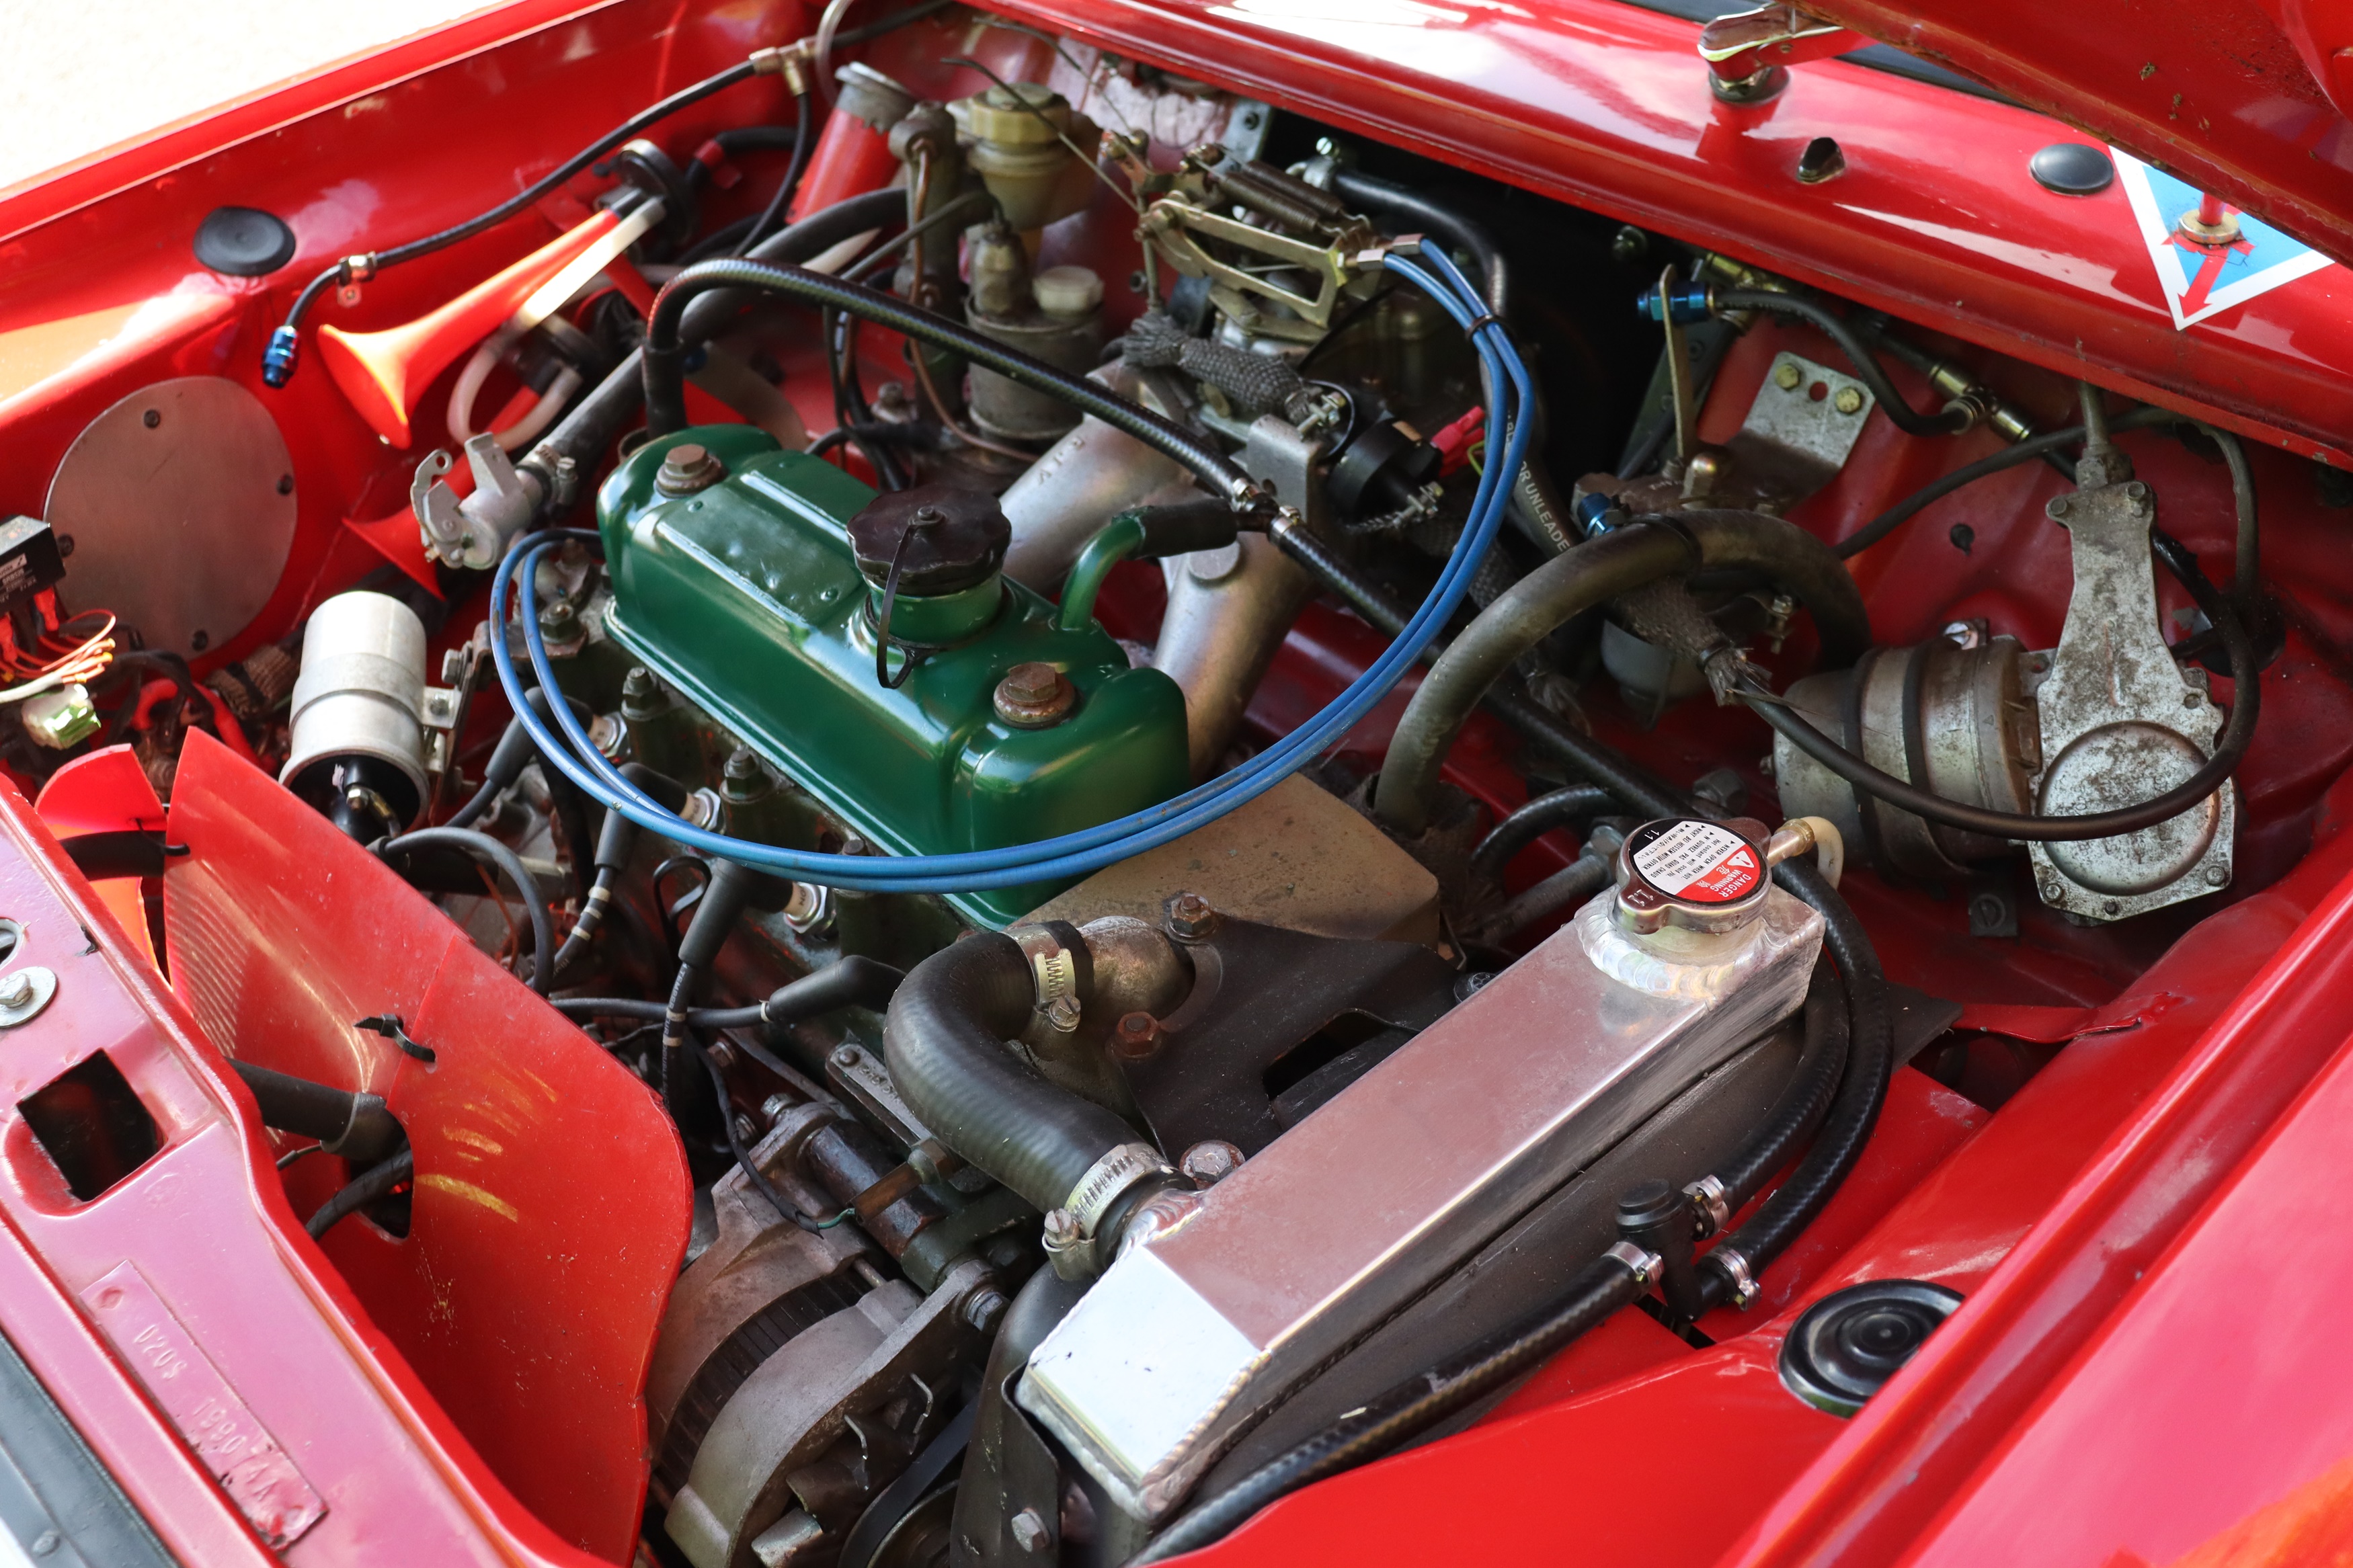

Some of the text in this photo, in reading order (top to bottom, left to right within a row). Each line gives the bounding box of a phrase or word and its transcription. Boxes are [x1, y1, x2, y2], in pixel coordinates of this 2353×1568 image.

[1525, 483, 1570, 552] UNLEADE
[1644, 829, 1660, 840] 1.1
[1689, 827, 1703, 837] NICHT
[1687, 840, 1705, 853] OUVREZ
[1696, 845, 1712, 858] coolant
[1715, 843, 1730, 856] NEVER
[1679, 852, 1689, 860] PAS
[1704, 854, 1716, 865] OPEN
[1665, 860, 1679, 868] QUAND
[1691, 864, 1705, 874] WHEN
[1716, 864, 1730, 874] 危
[1710, 869, 1743, 891] WARNING
[1718, 874, 1752, 897] DANGER
[1628, 889, 1653, 907] 1.1
